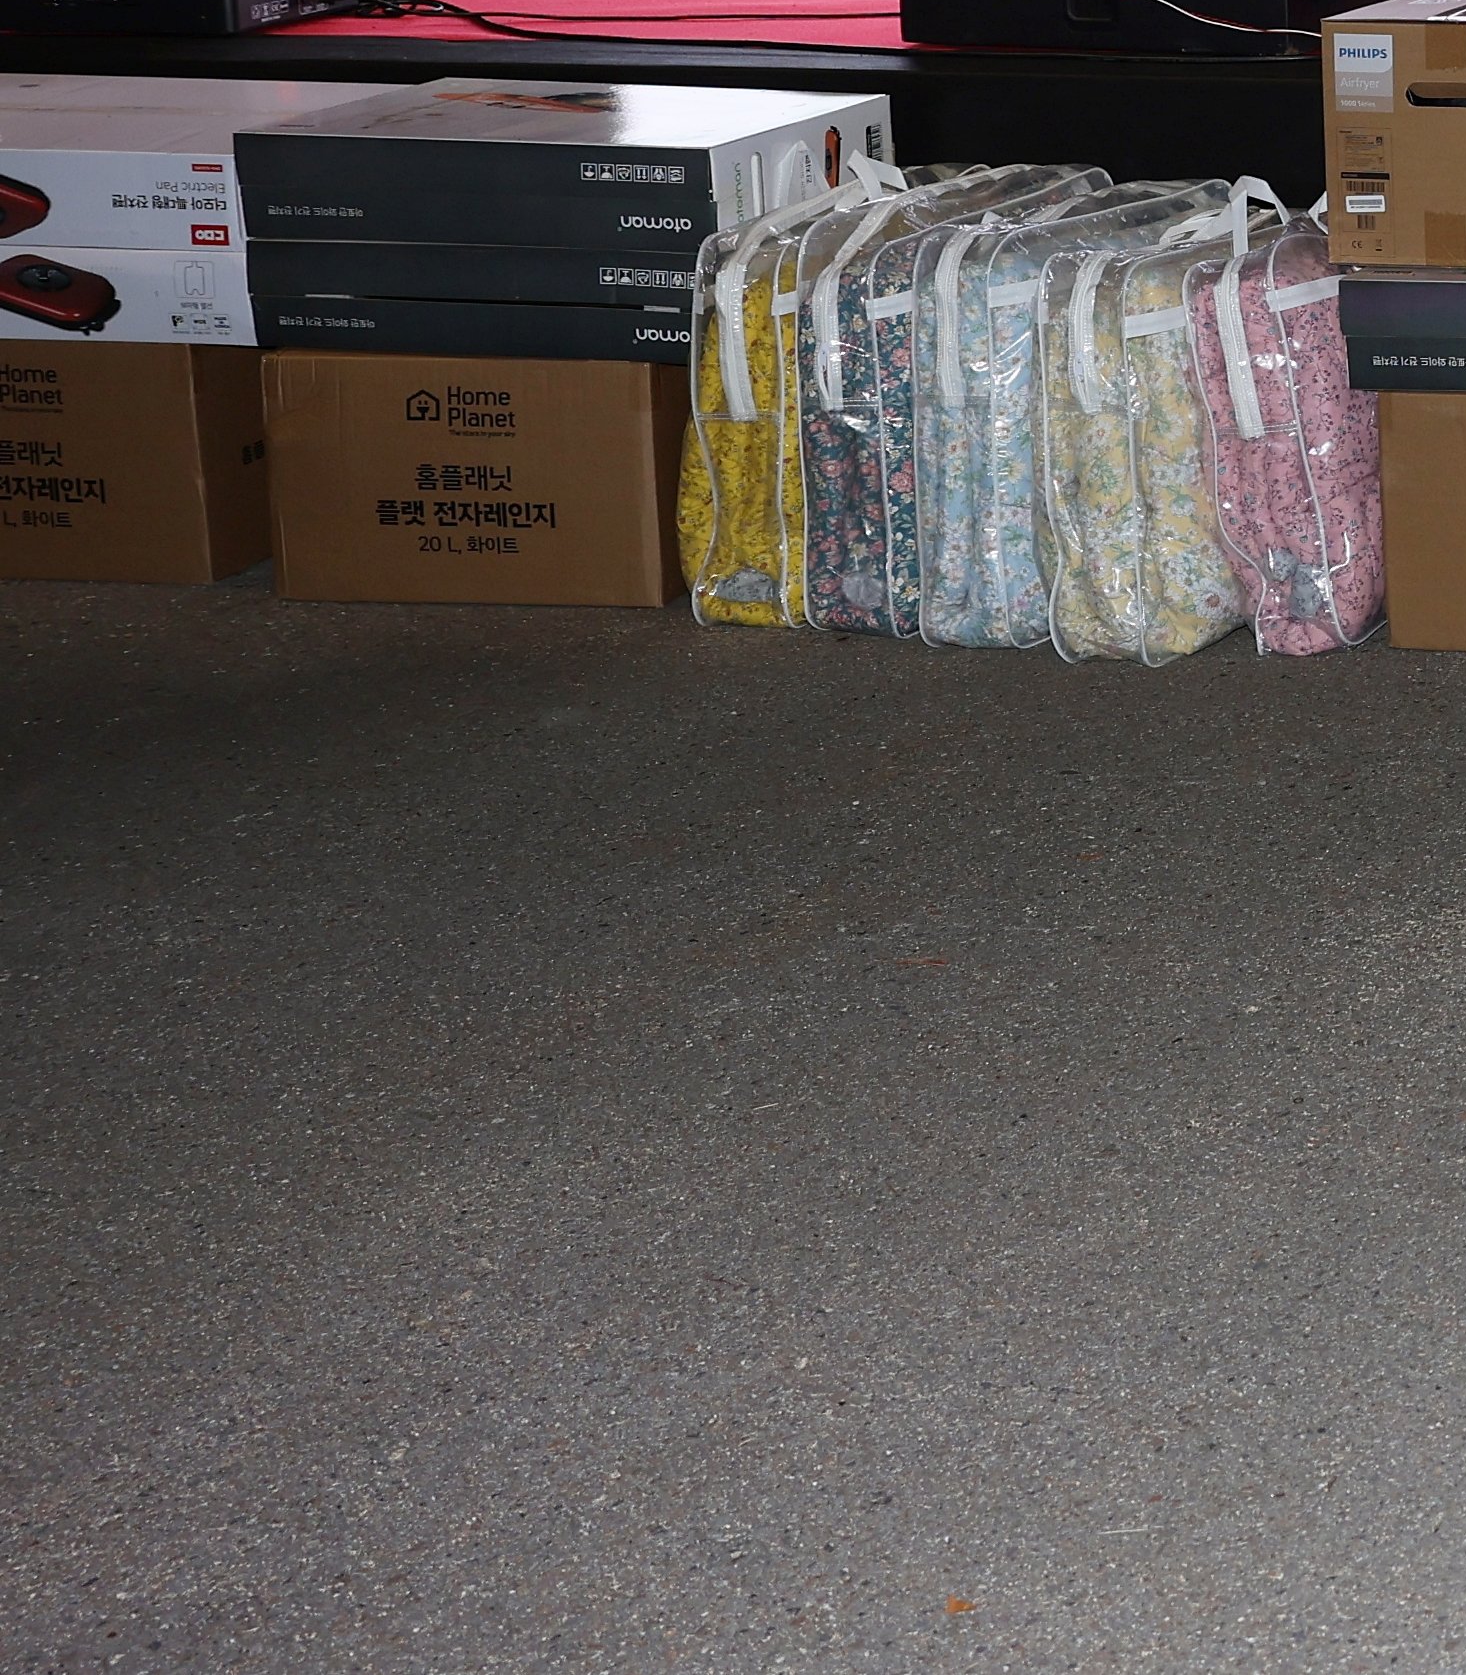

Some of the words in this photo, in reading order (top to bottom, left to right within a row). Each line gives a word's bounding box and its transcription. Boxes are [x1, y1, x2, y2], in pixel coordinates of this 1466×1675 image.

[1339, 47, 1388, 59] PHILIPS
[1340, 77, 1380, 90] Airfryer
[156, 181, 178, 192] Pan
[181, 183, 225, 194] Electric
[112, 194, 149, 209] 잔치팬
[152, 196, 187, 210] 특대형
[192, 198, 227, 211] 더모아
[620, 214, 692, 232] atoman
[635, 327, 691, 344] oman
[1401, 357, 1418, 367] 전기
[1420, 357, 1447, 367] 와이드
[0, 384, 63, 405] Planet
[447, 385, 510, 406] Home
[448, 407, 516, 428] Planet
[415, 464, 513, 491] 홈플래닛
[21, 511, 73, 528] 화이트
[376, 500, 426, 526] 플랫
[433, 501, 556, 529] 전자레인지
[418, 536, 442, 552] 20
[448, 536, 462, 554] L,
[467, 535, 520, 555] 화이트
